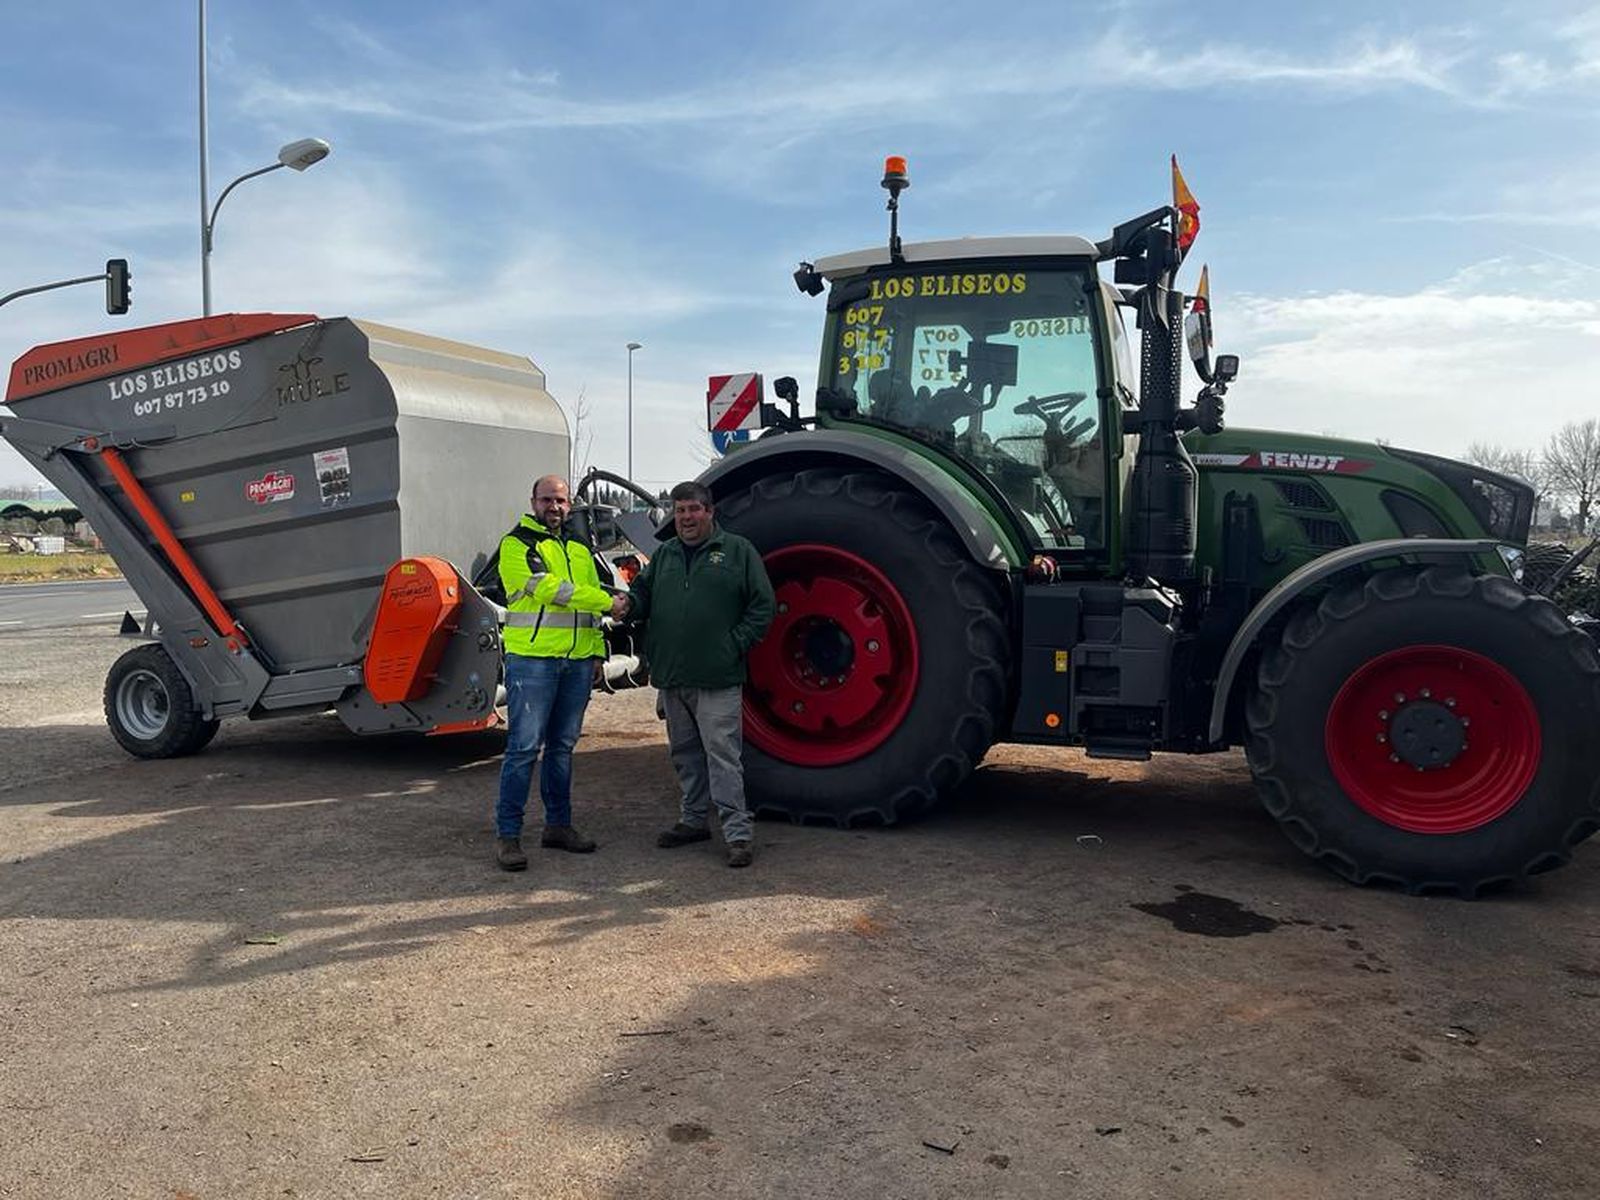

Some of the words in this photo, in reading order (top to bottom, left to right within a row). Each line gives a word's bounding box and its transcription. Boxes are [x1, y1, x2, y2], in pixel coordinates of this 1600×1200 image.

[871, 276, 915, 300] LOS
[919, 273, 1026, 296] ELISEOS
[846, 306, 884, 326] 607
[24, 344, 119, 385] PROMAGRI
[108, 374, 148, 400] LOS
[151, 350, 242, 389] ELISEOS
[134, 398, 161, 416] 607
[164, 392, 184, 409] 87
[187, 386, 207, 405] 73
[210, 380, 230, 397] 10
[1260, 451, 1345, 471] FENDT
